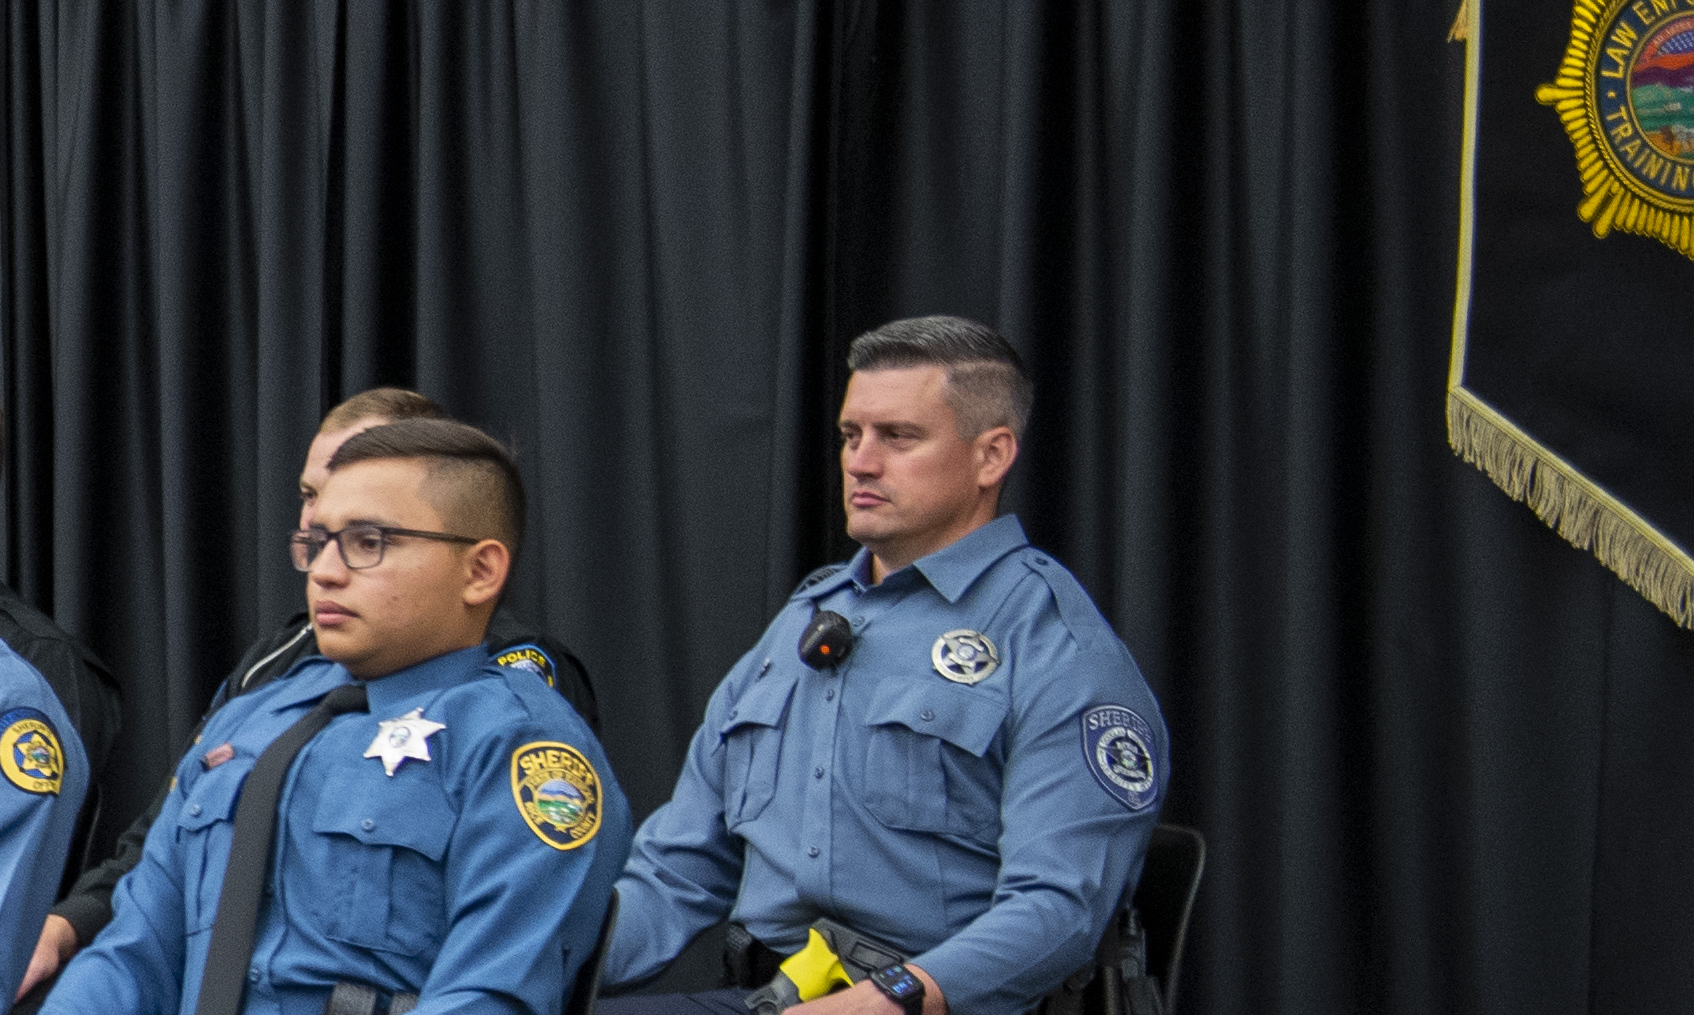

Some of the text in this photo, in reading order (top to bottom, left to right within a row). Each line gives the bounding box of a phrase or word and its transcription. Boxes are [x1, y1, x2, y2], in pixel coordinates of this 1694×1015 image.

[1601, 20, 1638, 79] LAW
[1605, 106, 1694, 193] TRAININ
[497, 649, 546, 669] POLICE
[1088, 710, 1152, 744] SHERIFF
[519, 750, 593, 786] SHERIFF
